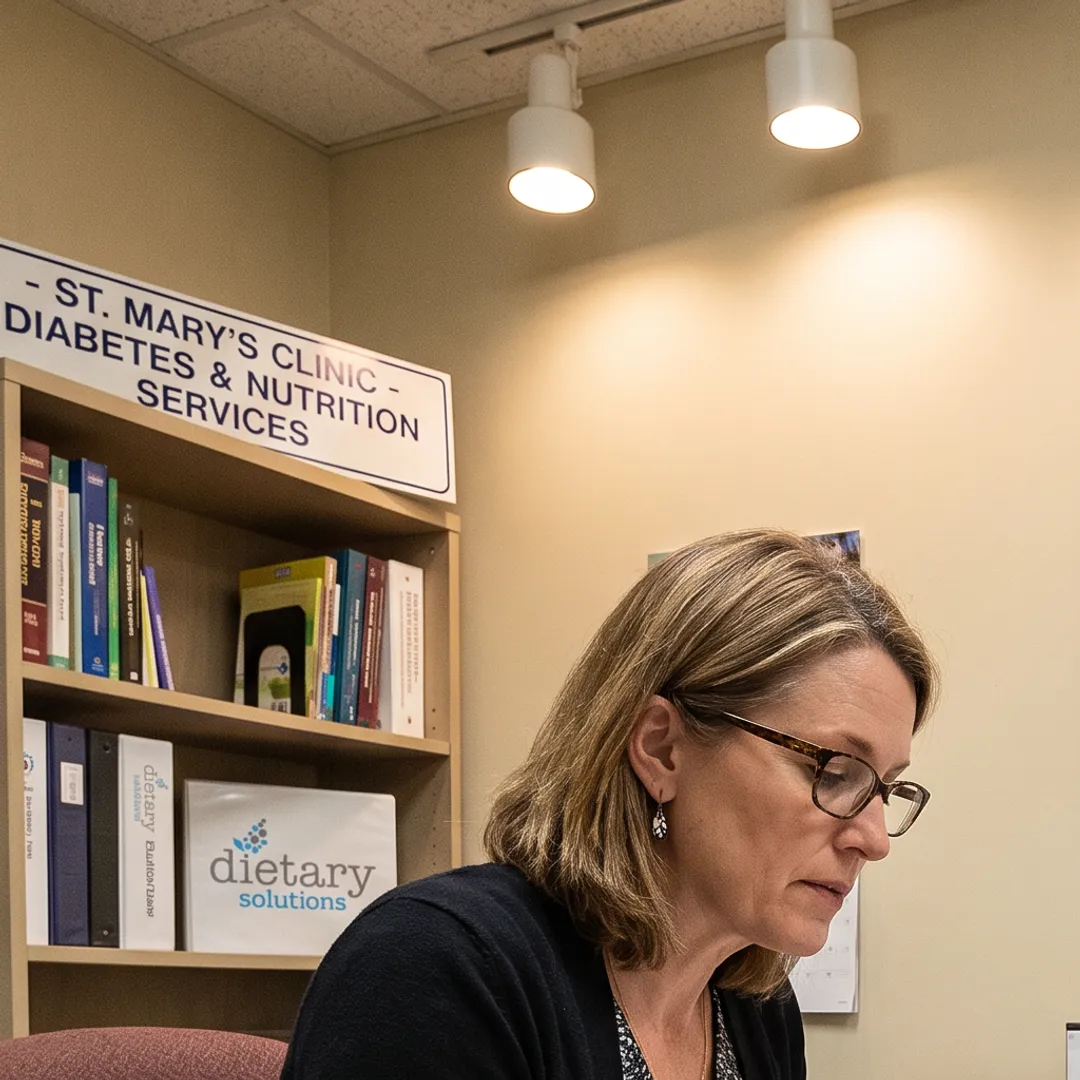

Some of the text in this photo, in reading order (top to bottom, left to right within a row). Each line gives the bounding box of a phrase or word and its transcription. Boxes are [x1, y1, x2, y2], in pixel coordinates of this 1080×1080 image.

[55, 277, 109, 318] ST.
[124, 297, 259, 359] MARY'S
[271, 342, 377, 393] CLINIC
[5, 303, 420, 442] DIABETES & NUTRITION
[137, 379, 310, 447] SERVICES
[210, 848, 376, 898] dietary
[239, 889, 347, 911] solutions
